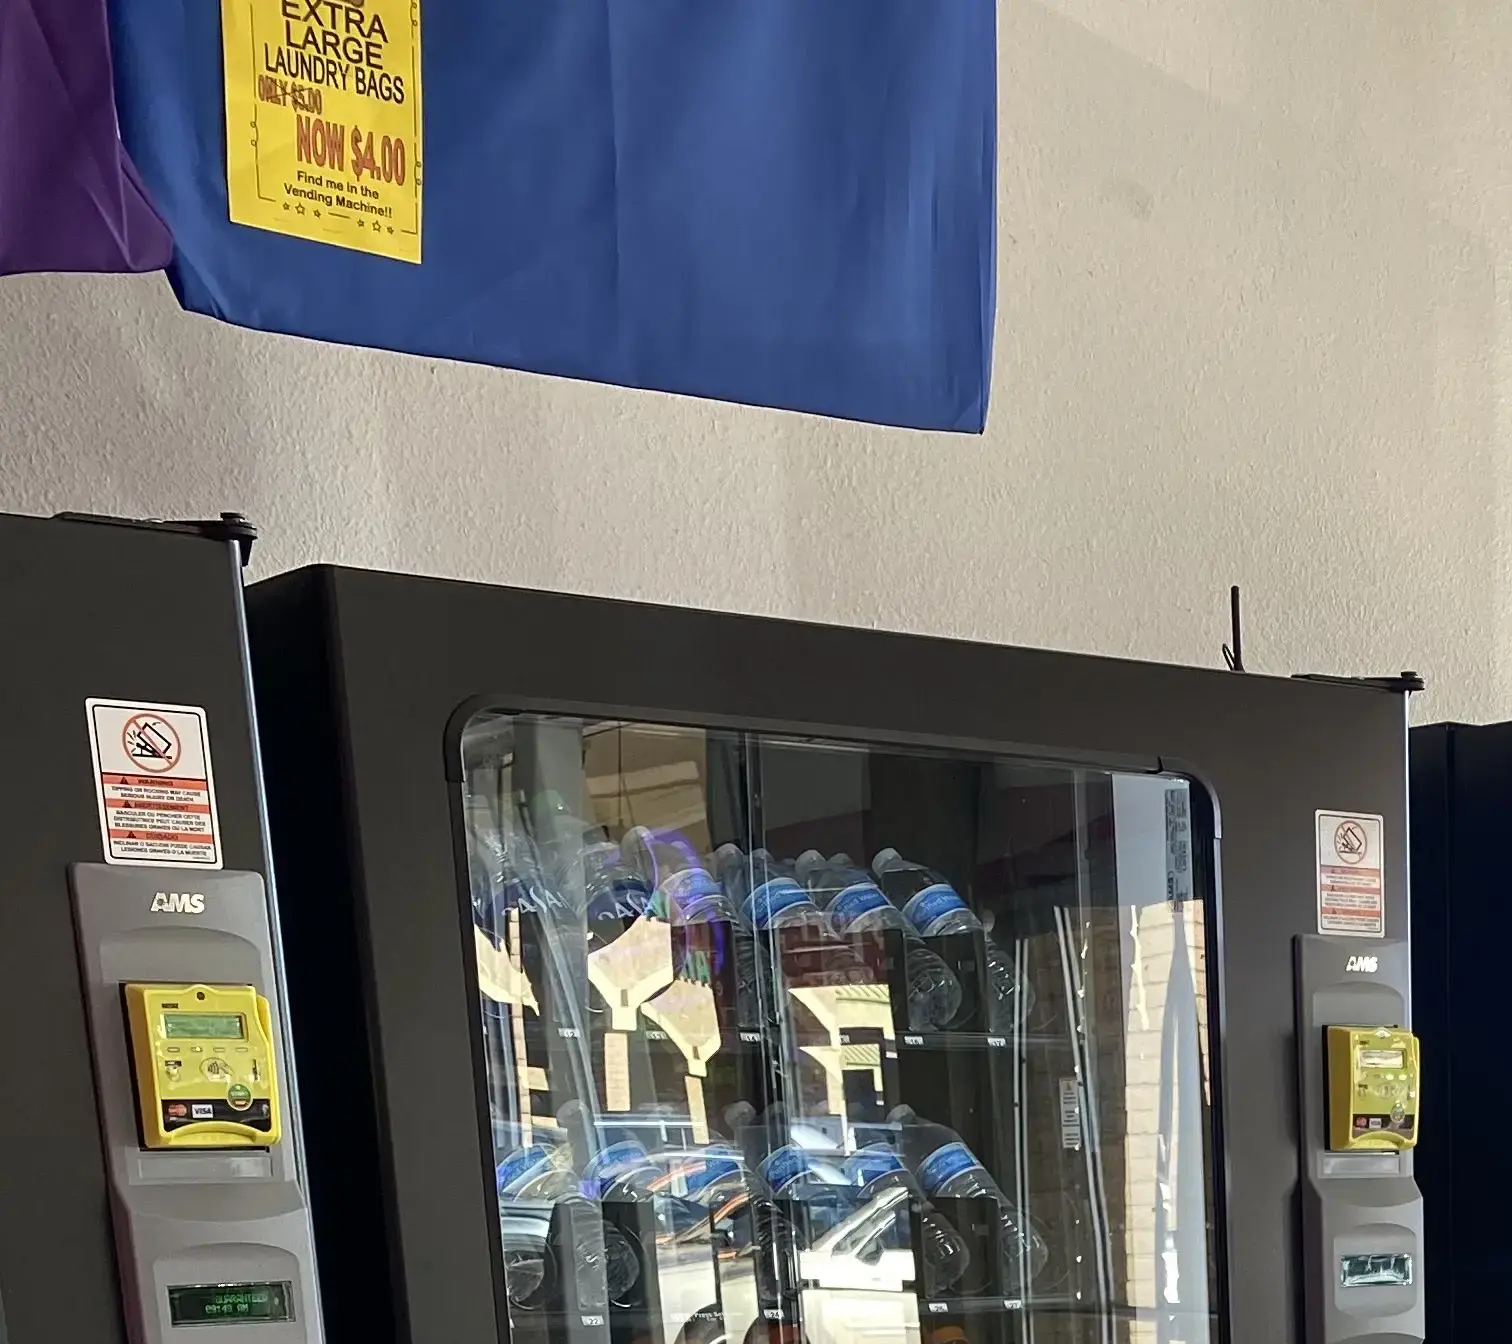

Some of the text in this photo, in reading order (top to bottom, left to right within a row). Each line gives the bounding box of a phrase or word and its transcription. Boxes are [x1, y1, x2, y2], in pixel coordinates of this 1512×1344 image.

[282, 0, 389, 43] EXTRA
[285, 20, 384, 70] LARGE
[264, 43, 405, 104] LAUNDRY BAGS
[296, 114, 406, 186] NOW $4.00
[284, 183, 393, 219] Vending Machine!!
[297, 171, 379, 200] Find me in the
[150, 892, 205, 913] AMS
[1346, 956, 1378, 973] AMS
